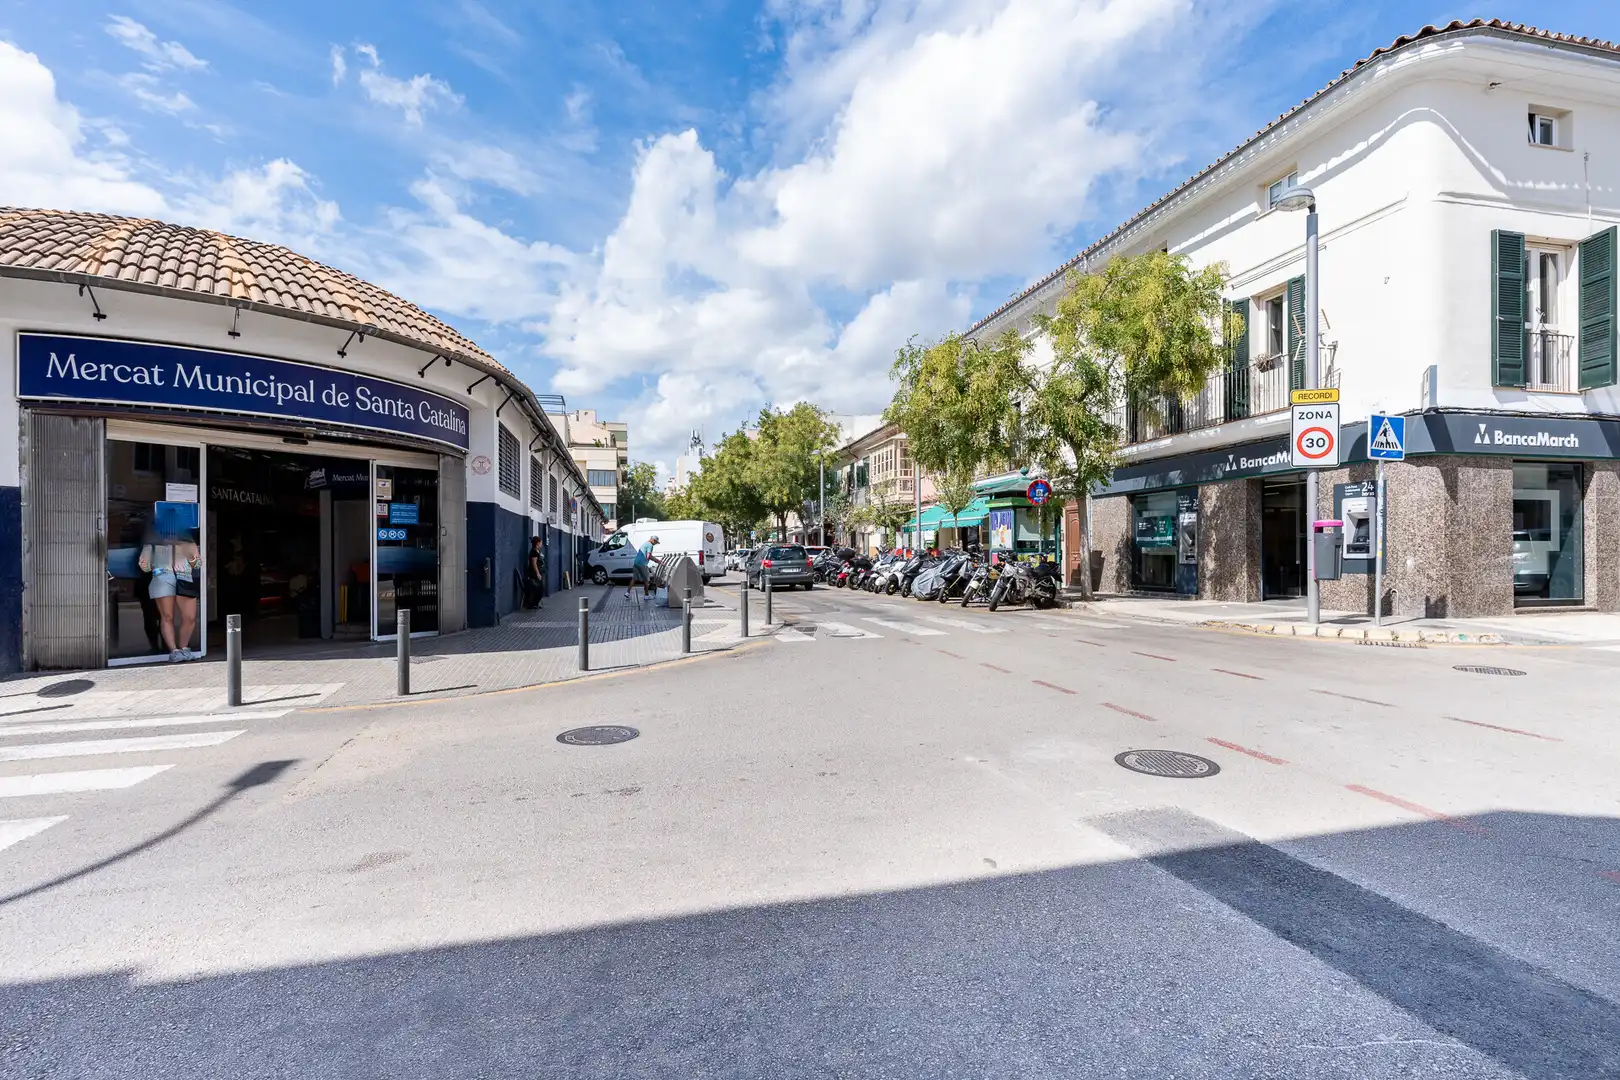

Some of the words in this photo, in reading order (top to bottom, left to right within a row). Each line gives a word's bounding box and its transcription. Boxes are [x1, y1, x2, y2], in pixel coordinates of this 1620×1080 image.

[46, 352, 165, 386] Mercat
[173, 362, 314, 406] Municipal
[321, 383, 350, 408] de
[355, 386, 415, 421] Santa
[418, 400, 466, 436] Catalina
[1297, 392, 1333, 400] RECORDI
[1298, 410, 1333, 420] ZONA
[1305, 437, 1326, 448] 30
[1494, 430, 1579, 448] BancaMarch
[332, 473, 355, 482] Mercat
[1361, 481, 1374, 492] 24
[211, 485, 239, 502] SANTA
